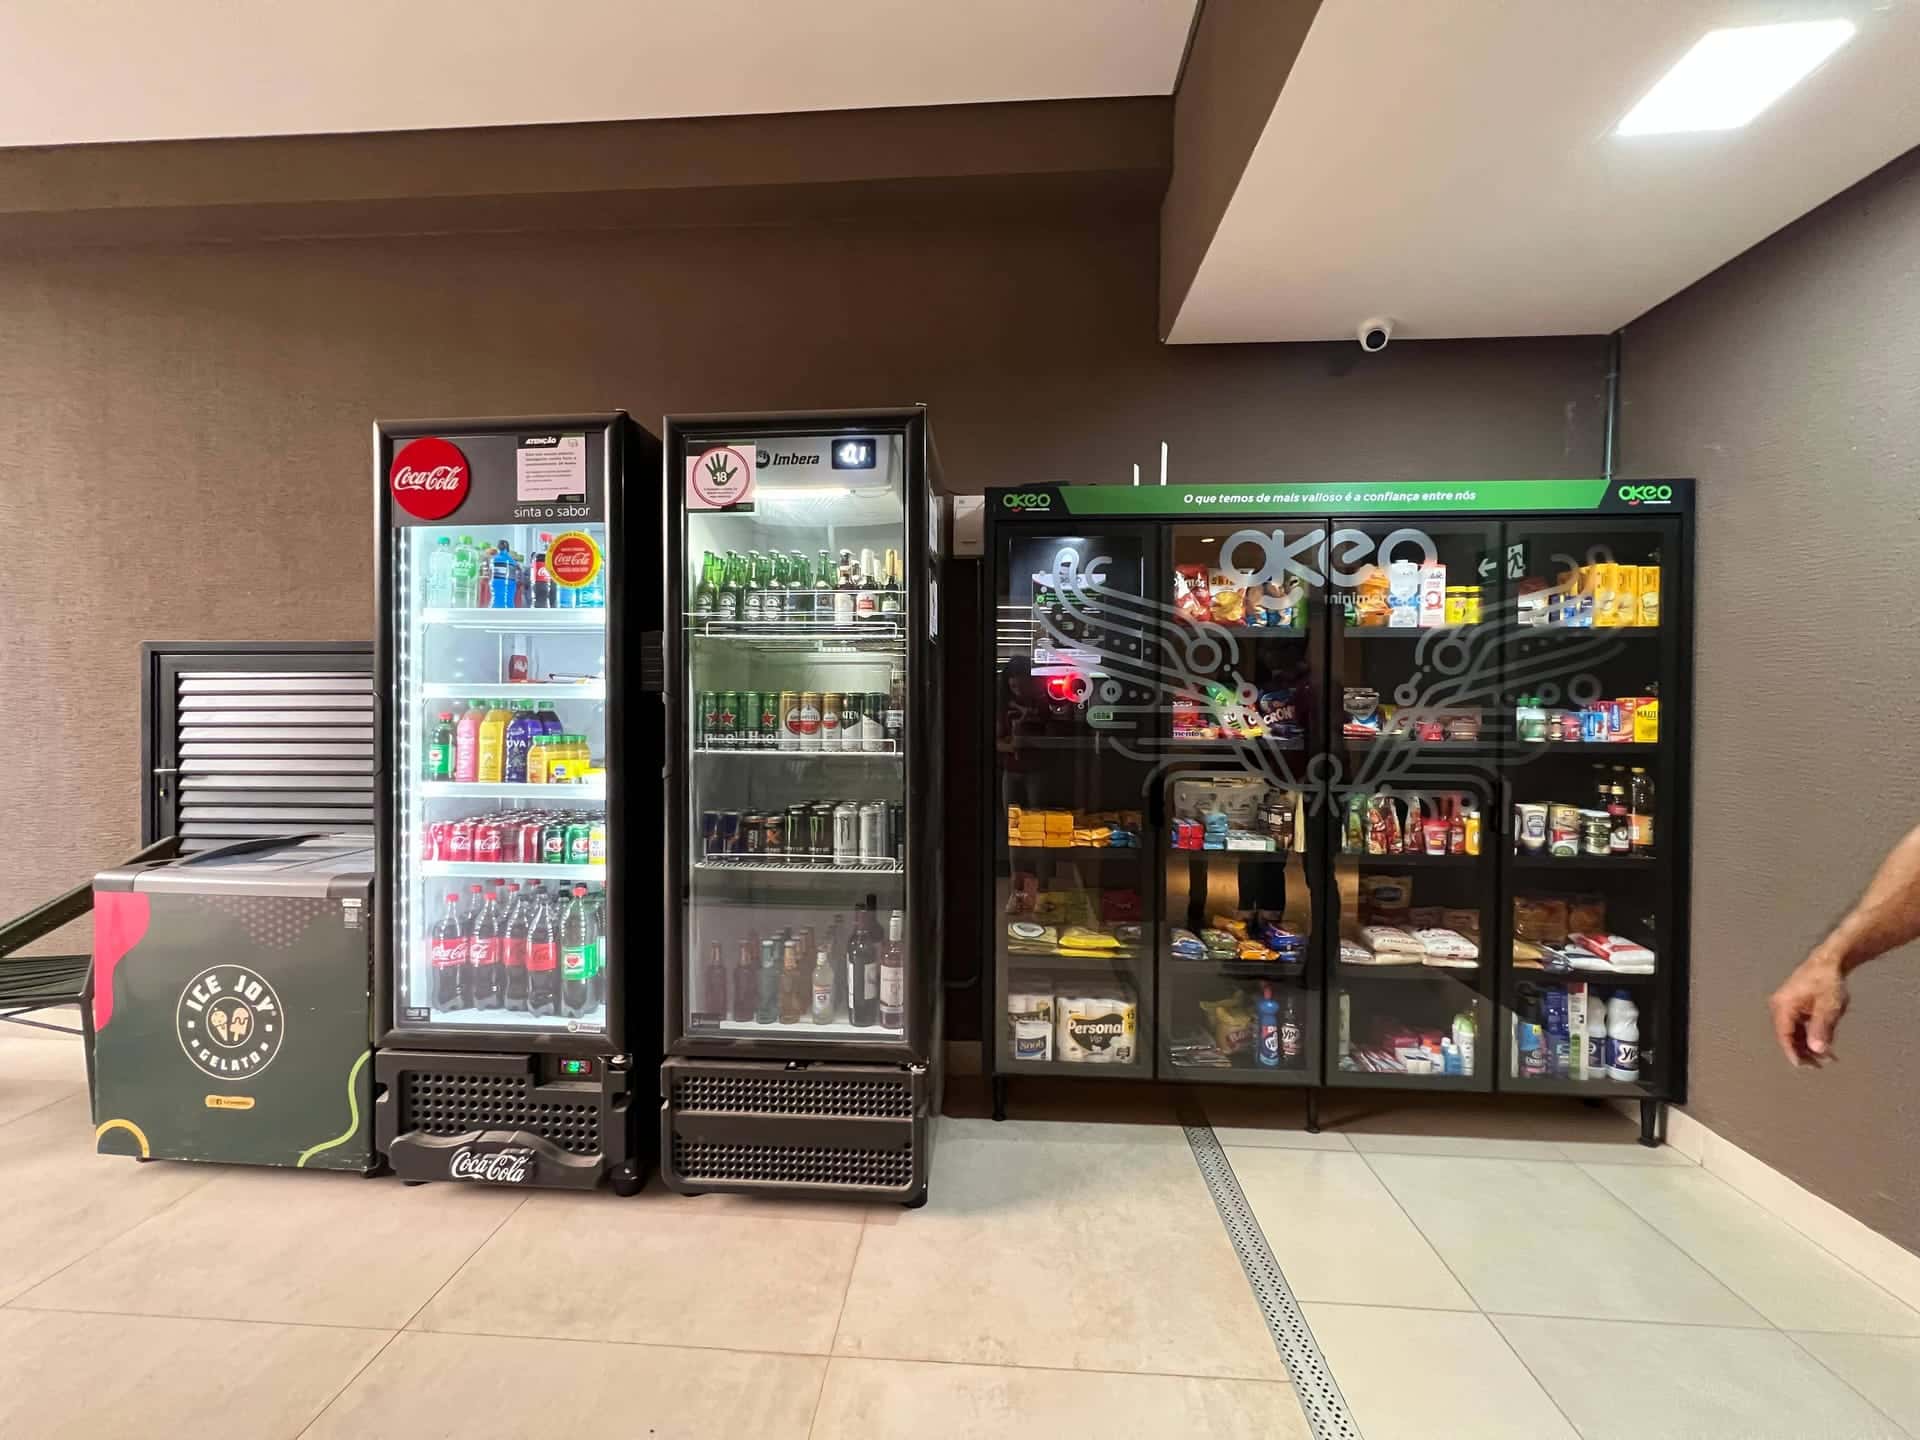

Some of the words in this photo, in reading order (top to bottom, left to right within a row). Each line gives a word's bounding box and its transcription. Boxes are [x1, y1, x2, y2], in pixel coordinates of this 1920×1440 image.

[772, 453, 820, 465] Imbera
[713, 471, 727, 482] -18
[1183, 494, 1194, 503] O
[1195, 495, 1217, 505] que
[1218, 494, 1254, 503] temos
[1256, 493, 1271, 503] de
[1272, 493, 1299, 503] mais
[1300, 491, 1343, 502] valioso
[1344, 491, 1353, 501] é
[1353, 493, 1361, 501] a
[1363, 490, 1421, 503] confiança
[1422, 491, 1453, 501] entre
[1454, 490, 1476, 500] nós
[513, 507, 542, 518] sinta
[545, 508, 553, 517] o
[556, 505, 591, 518] sabor
[186, 974, 222, 1012] ICE
[233, 974, 275, 1012] JOY
[1067, 1019, 1126, 1034] Personal
[199, 1048, 261, 1071] GELATO
